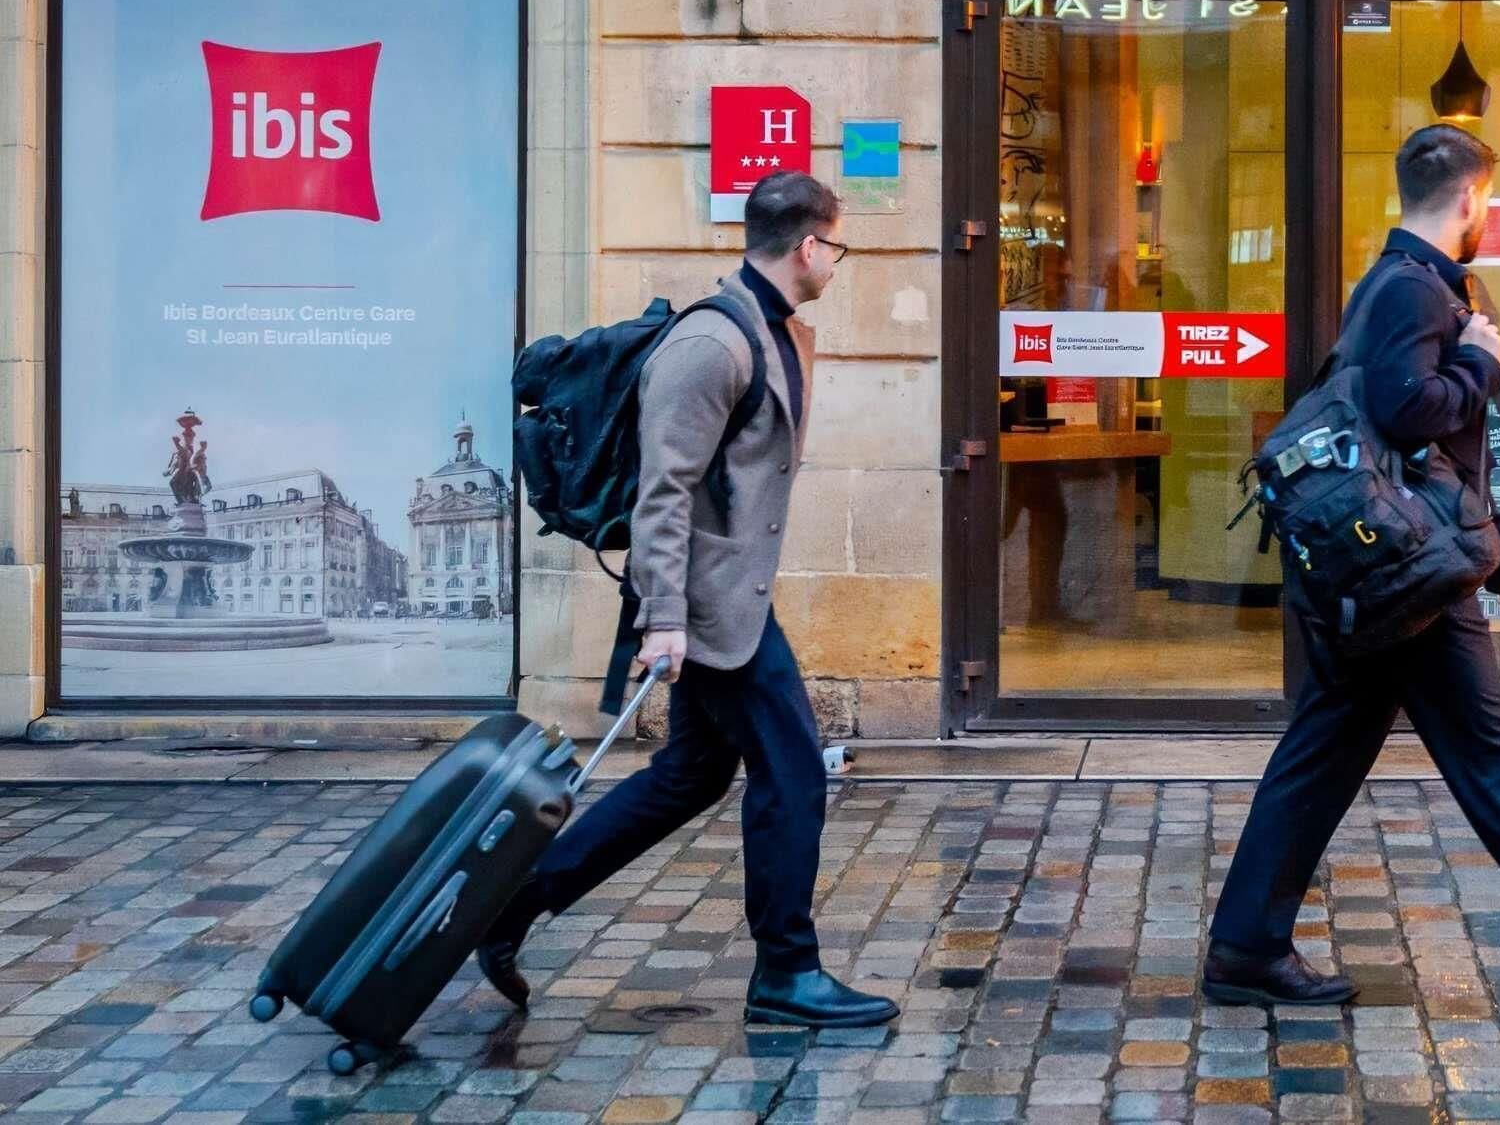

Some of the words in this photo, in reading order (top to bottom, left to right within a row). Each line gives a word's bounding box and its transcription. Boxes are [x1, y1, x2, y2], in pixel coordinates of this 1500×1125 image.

[231, 92, 352, 159] ibis
[760, 109, 798, 144] H
[163, 305, 198, 321] Ibis
[202, 303, 296, 322] Bordeaux
[299, 305, 365, 322] Centre
[369, 305, 417, 322] Gare
[186, 329, 208, 346] St
[212, 330, 259, 346] Jean
[264, 328, 393, 349] Euratlantique
[1018, 334, 1047, 351] ibis
[1177, 325, 1230, 341] TIREZ
[1181, 349, 1226, 365] PULL
